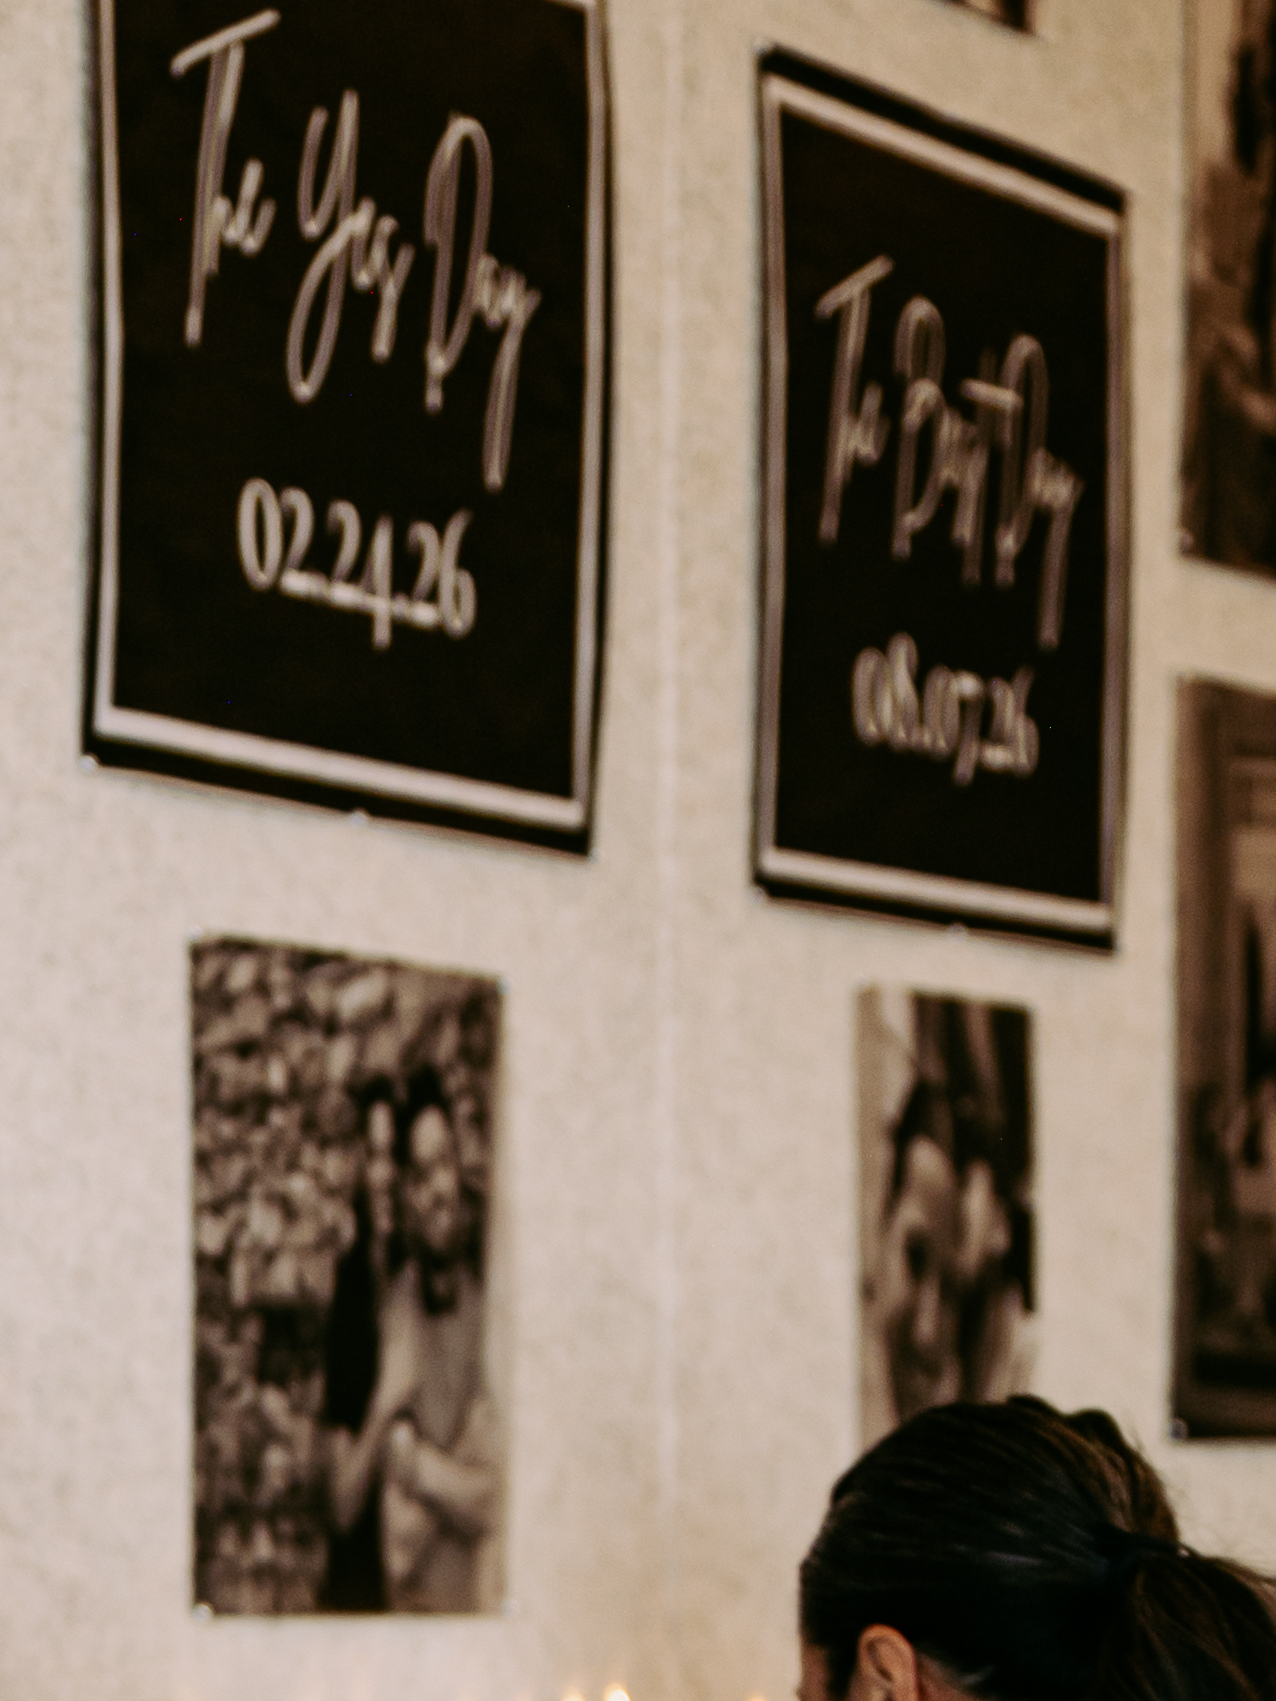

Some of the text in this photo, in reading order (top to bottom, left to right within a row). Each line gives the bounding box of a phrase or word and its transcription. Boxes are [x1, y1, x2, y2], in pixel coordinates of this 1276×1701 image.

[171, 8, 541, 491] The Yes Day
[238, 477, 478, 650] 02.24.26
[816, 255, 1086, 650] The Best Day
